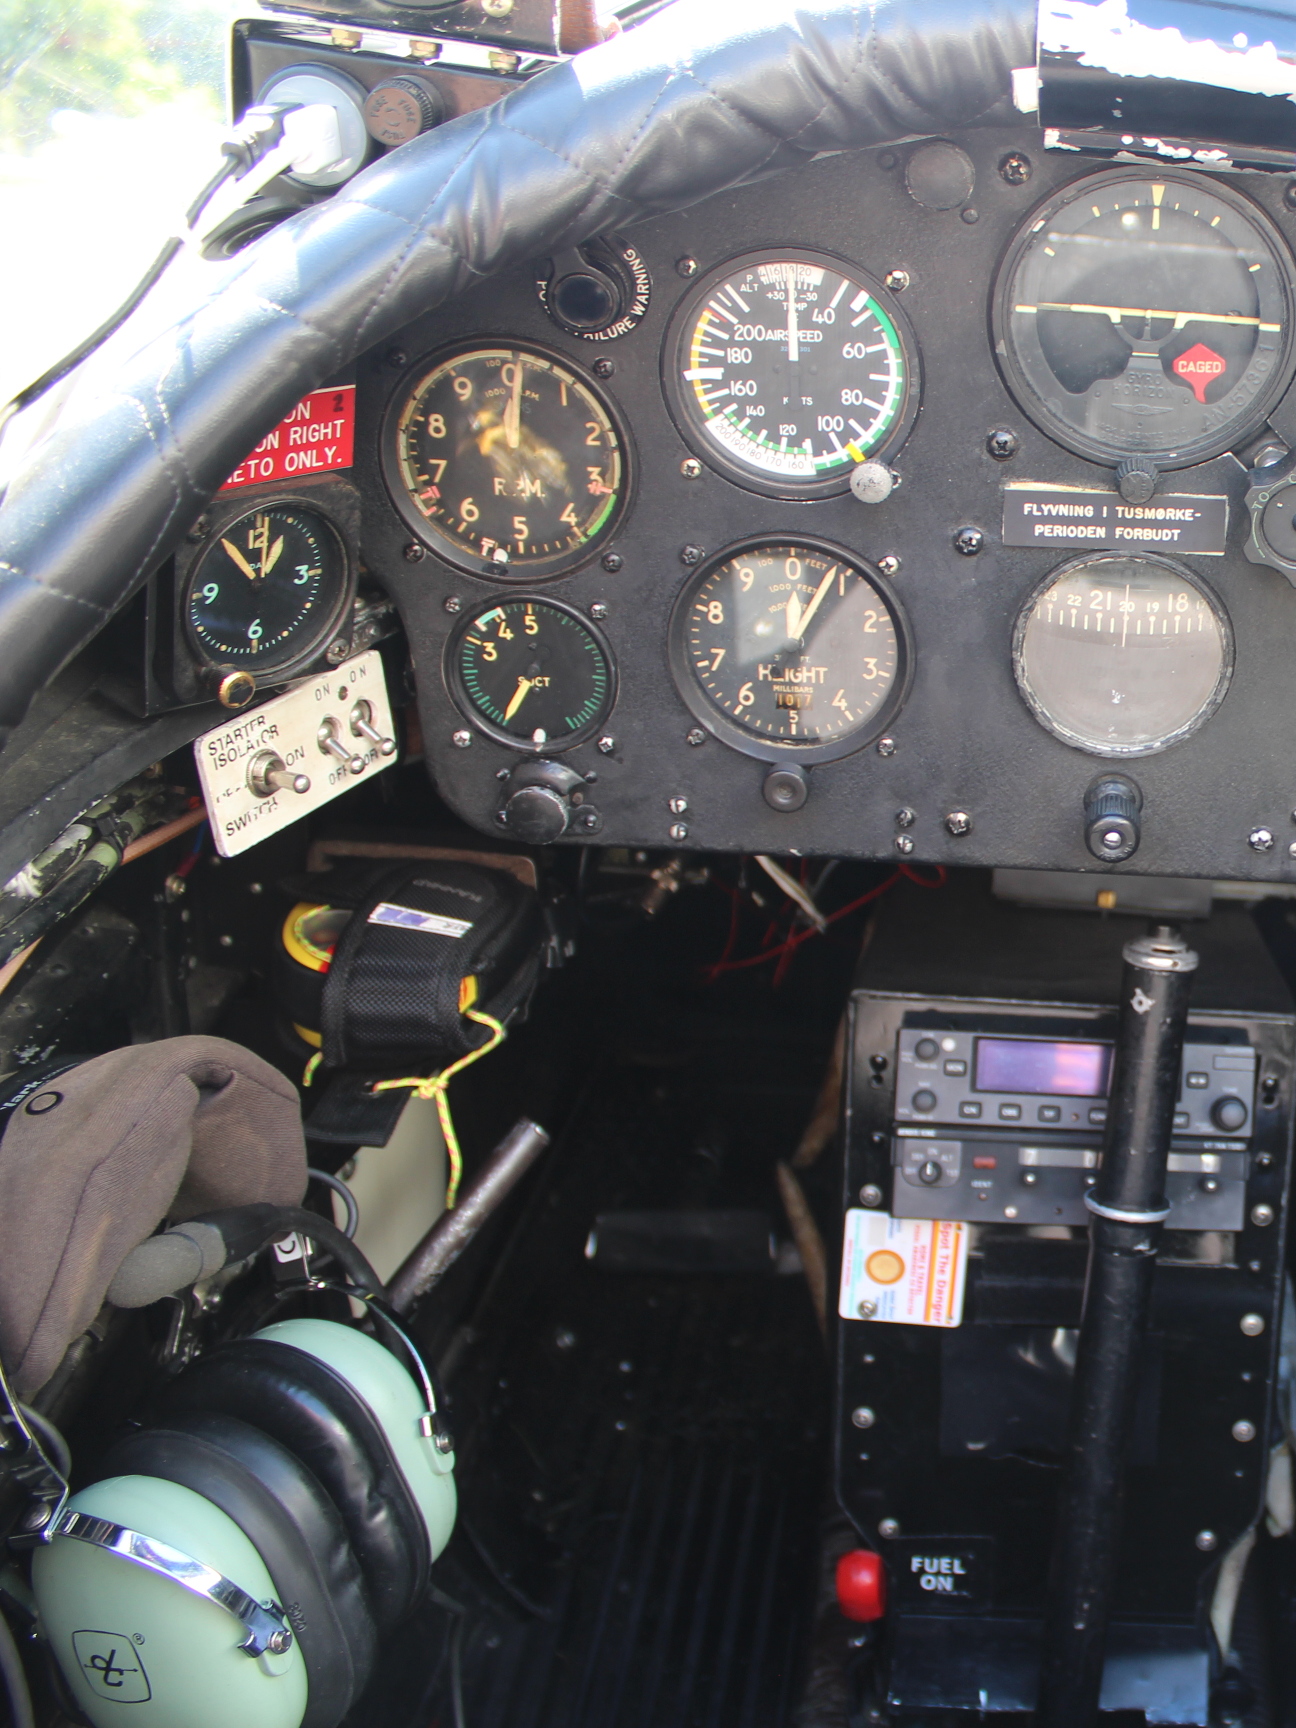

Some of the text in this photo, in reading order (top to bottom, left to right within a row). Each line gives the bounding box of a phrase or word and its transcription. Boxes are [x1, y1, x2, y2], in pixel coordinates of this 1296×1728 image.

[746, 274, 754, 282] P
[799, 266, 812, 277] 20
[623, 248, 649, 316] WARNING
[740, 283, 758, 292] ALT
[782, 302, 808, 311] TMP
[812, 308, 835, 324] 40
[734, 324, 765, 342] 200
[726, 348, 752, 364] 180
[842, 342, 866, 358] 60
[1178, 361, 1222, 373] CAGED
[1127, 372, 1163, 385] GYRO
[453, 377, 472, 400] 9
[485, 388, 506, 398] 1000
[730, 380, 757, 396] 160
[783, 396, 812, 406] KTS
[841, 389, 862, 406] 80
[746, 406, 764, 416] 140
[289, 419, 345, 446] RIGHT
[428, 415, 446, 438] 8
[715, 423, 730, 440] 200
[779, 424, 796, 436] 120
[817, 416, 844, 432] 100
[585, 422, 600, 446] 2
[730, 436, 746, 450] 190
[226, 446, 342, 483] ETO ONLY.
[746, 449, 762, 462] 180
[765, 456, 782, 467] 170
[430, 461, 448, 482] 7
[788, 460, 804, 470] 160
[460, 500, 479, 523] 6
[559, 503, 577, 527] 4
[1023, 502, 1094, 518] FLYVNING
[1116, 506, 1202, 521] TUSMØRKE-
[512, 517, 528, 540] 5
[1034, 524, 1181, 541] PERIODEN FORBUDT
[248, 528, 268, 549] 12
[758, 558, 828, 570] 100 FEET
[784, 556, 800, 580] 0
[293, 565, 309, 584] 3
[739, 568, 754, 592] 9
[202, 583, 219, 605] 9
[1067, 594, 1082, 606] 22
[1090, 590, 1112, 611] 21
[1168, 593, 1189, 613] 18
[707, 600, 724, 624] 8
[1119, 601, 1135, 612] 20
[1147, 602, 1159, 613] 19
[248, 619, 263, 639] 6
[525, 615, 539, 635] 5
[864, 610, 877, 632] 2
[498, 621, 514, 640] 4
[482, 642, 497, 661] 3
[710, 648, 726, 672] 7
[350, 666, 367, 683] ON
[862, 658, 878, 680] 3
[315, 684, 331, 701] ON
[738, 682, 755, 706] 6
[773, 685, 813, 693] MILLIBARS
[832, 689, 848, 710] 4
[789, 710, 798, 724] 5
[285, 745, 305, 766] ON
[931, 1222, 952, 1323] Spot The Danger
[911, 1556, 966, 1575] FUEL
[920, 1575, 953, 1592] ON
